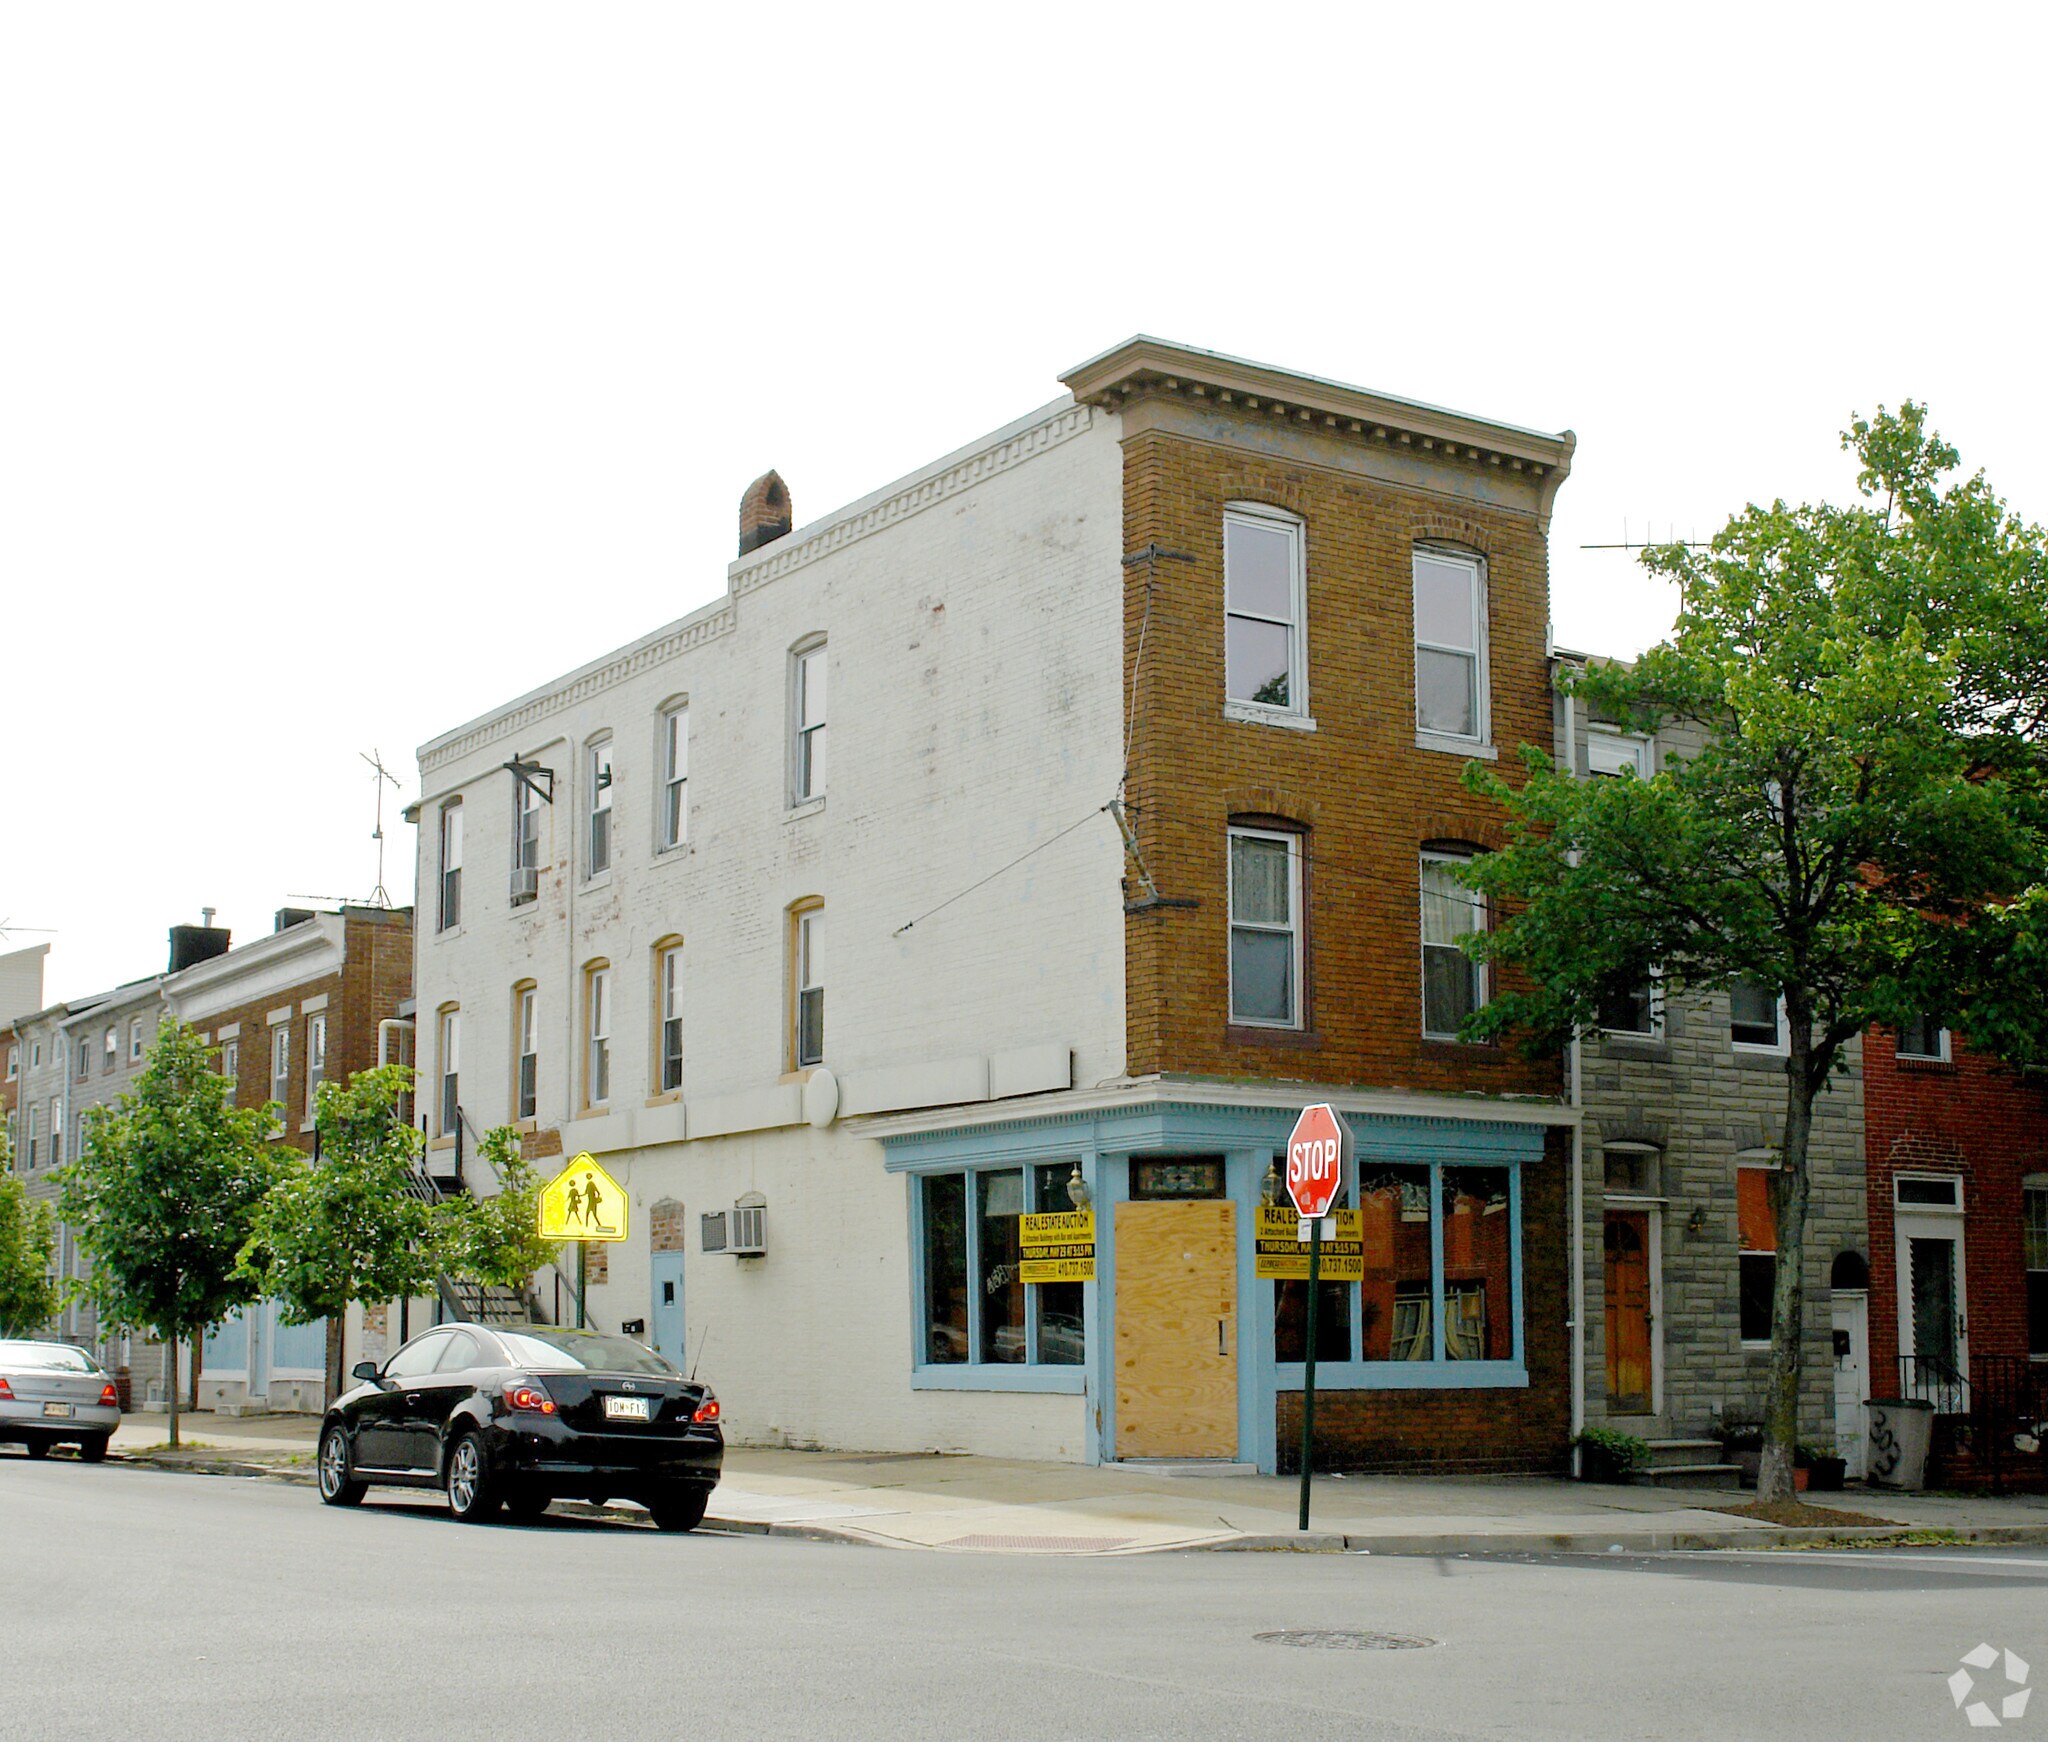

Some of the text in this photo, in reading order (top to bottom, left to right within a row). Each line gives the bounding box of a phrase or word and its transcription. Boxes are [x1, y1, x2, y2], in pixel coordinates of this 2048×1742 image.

[1290, 1139, 1337, 1183] STOP
[1026, 1213, 1089, 1231] REAL ESTATE AUCTION
[1264, 1209, 1287, 1224] REAL
[1085, 1244, 1093, 1256] PM
[1301, 1241, 1311, 1254] MA
[1350, 1242, 1360, 1255] PM
[1058, 1260, 1094, 1277] 410.737.1500
